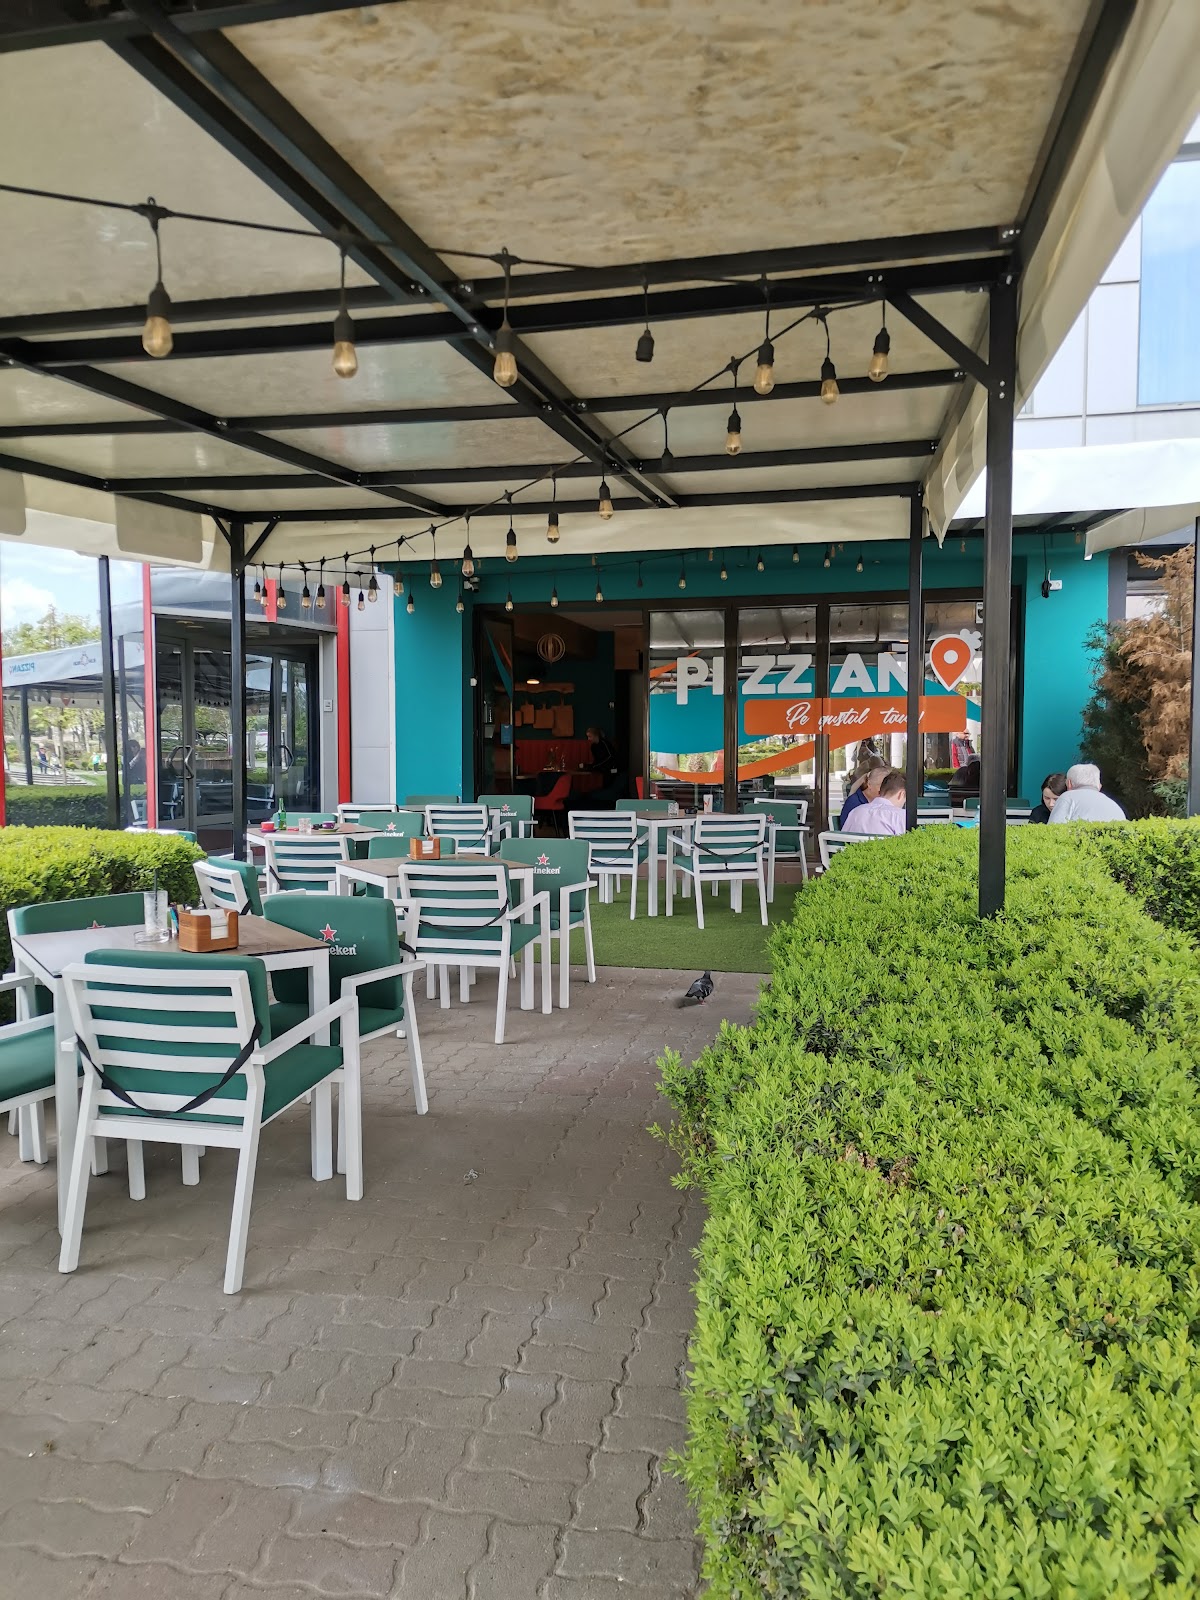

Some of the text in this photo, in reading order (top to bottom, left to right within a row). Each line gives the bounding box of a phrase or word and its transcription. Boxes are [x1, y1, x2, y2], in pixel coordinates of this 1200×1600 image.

[786, 702, 811, 729] Pe
[818, 708, 870, 731] gustul
[533, 866, 561, 874] ineken
[329, 944, 357, 955] eken
